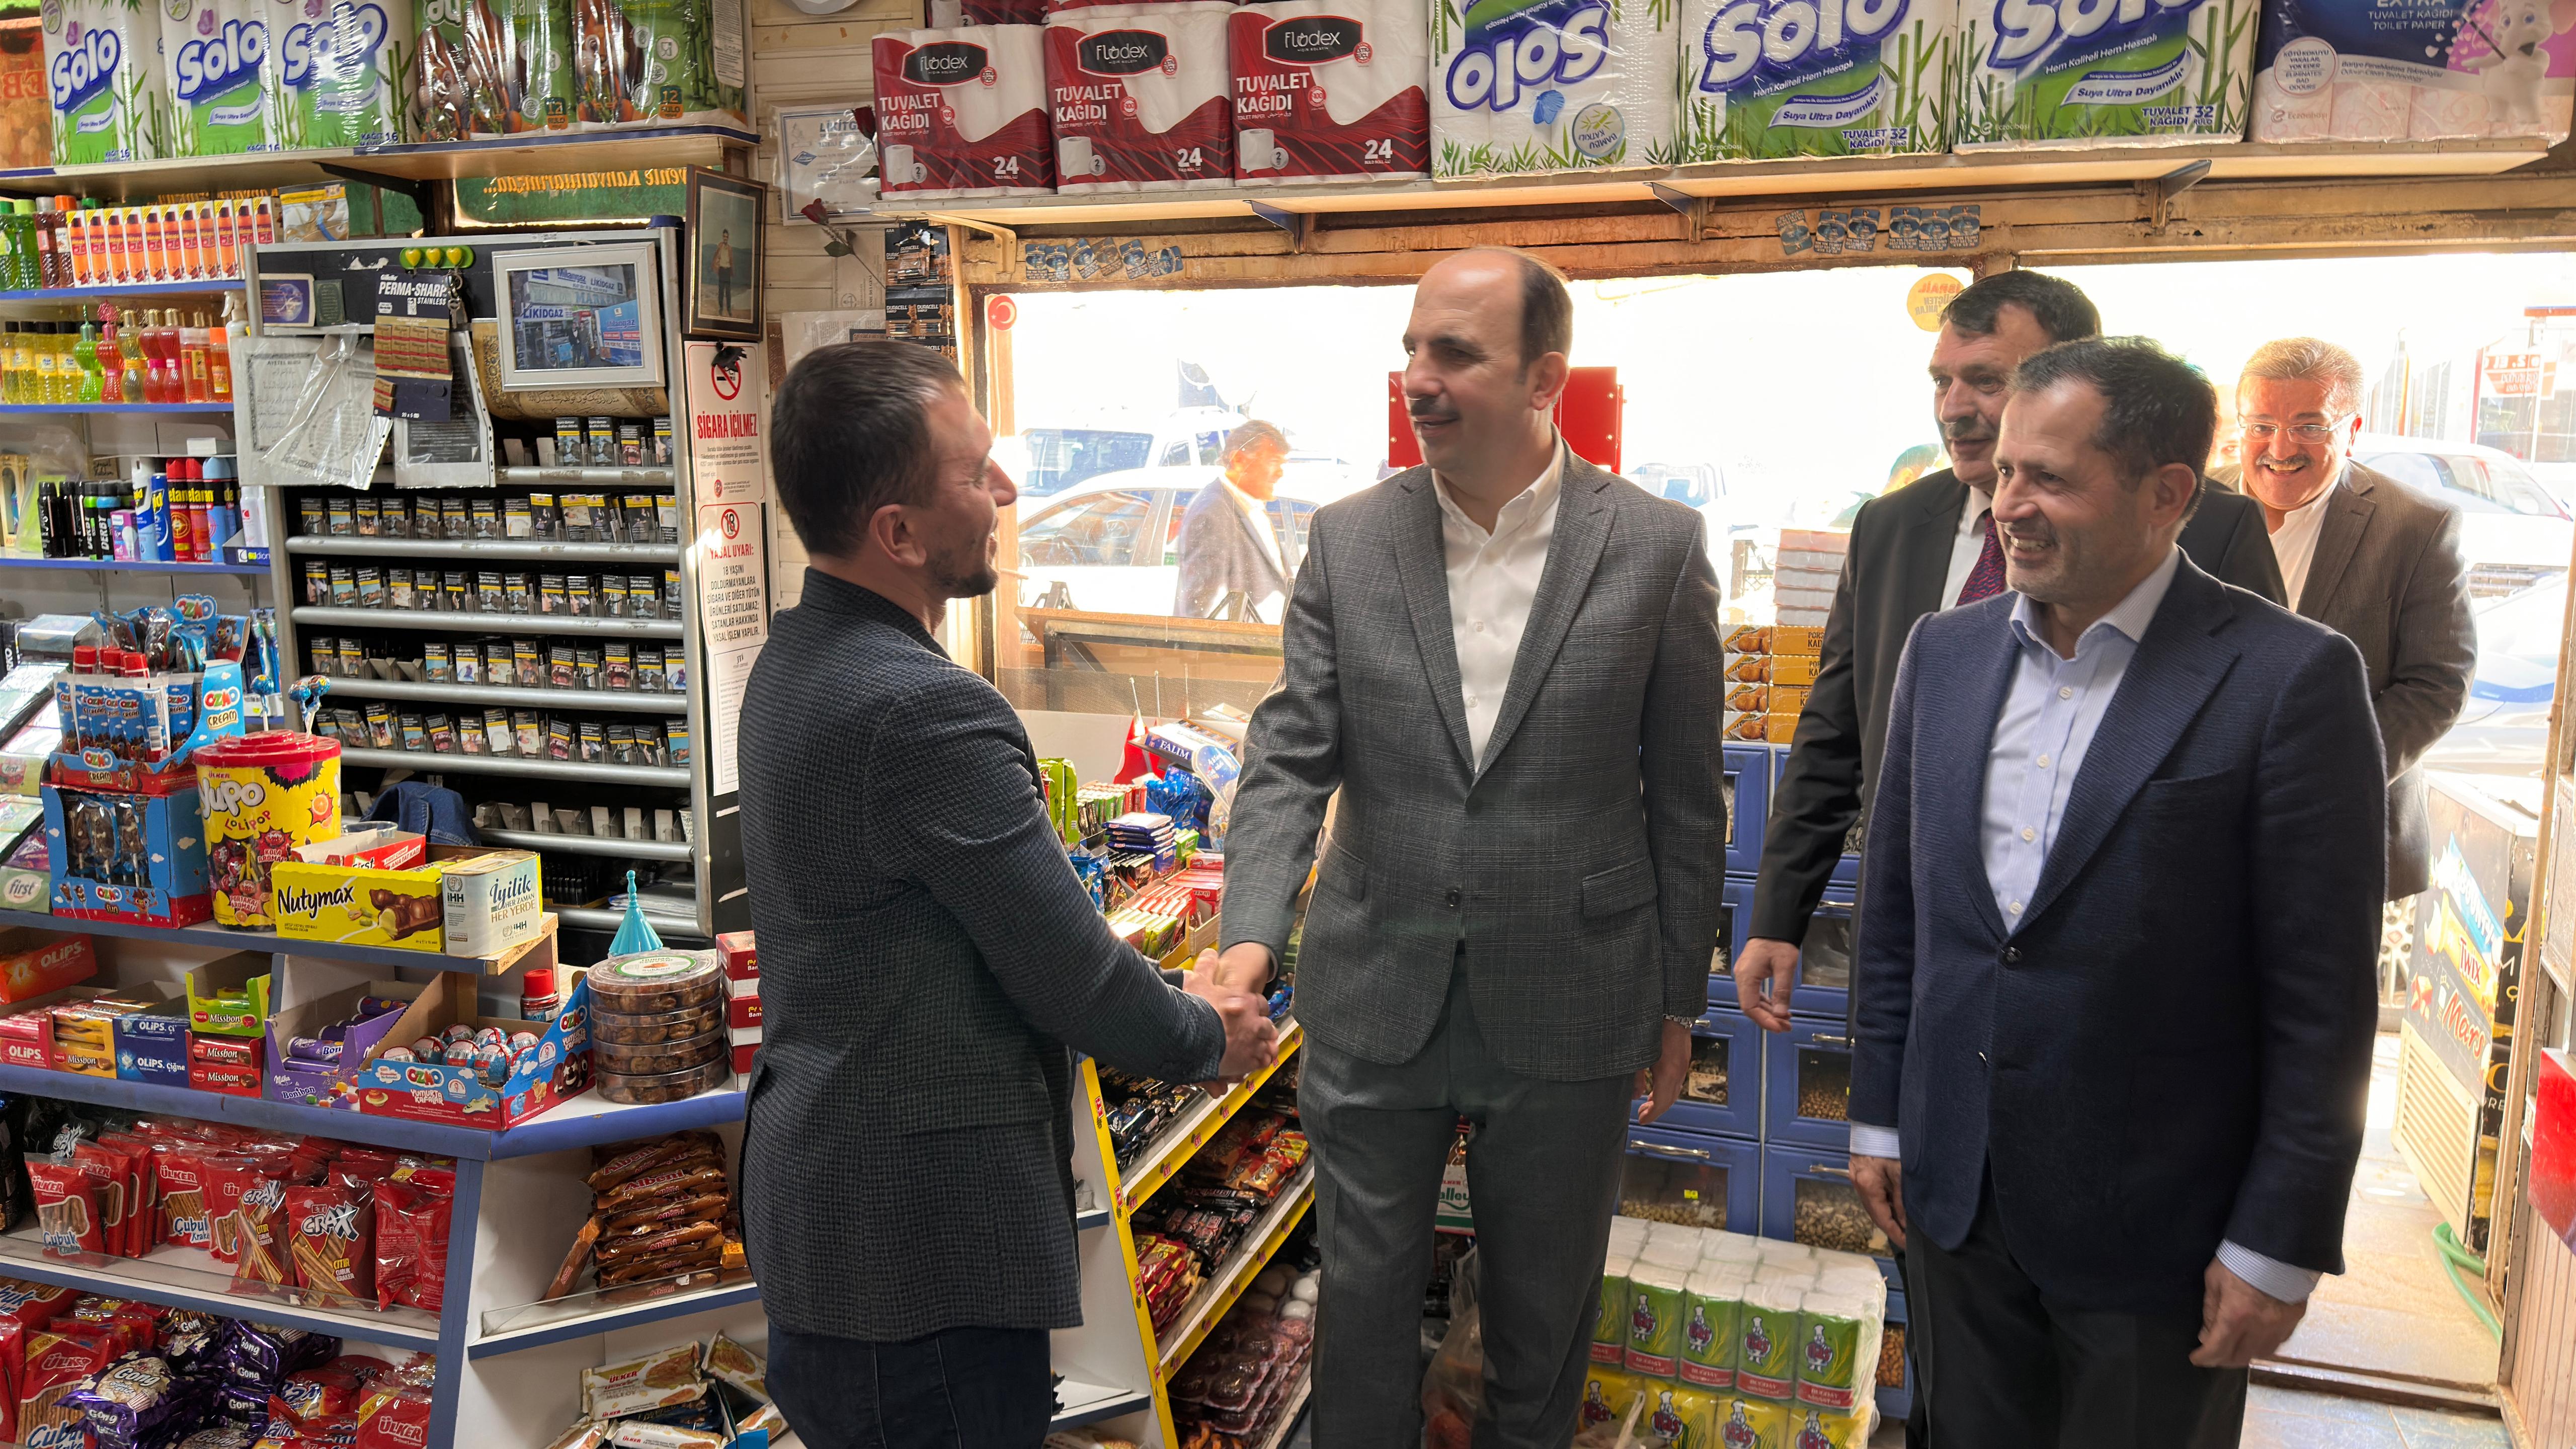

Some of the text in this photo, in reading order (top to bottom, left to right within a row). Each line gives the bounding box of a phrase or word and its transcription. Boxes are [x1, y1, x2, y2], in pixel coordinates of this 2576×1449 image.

[2368, 11, 2412, 19] TUVALET
[2373, 20, 2445, 31] TOILET PAPER
[2045, 33, 2157, 75] Hem Kaliteli Hem Hesaplı
[1237, 72, 1310, 93] TUVALET
[1774, 76, 1801, 92] Kaliteli
[1802, 71, 1822, 83] Hem
[1823, 60, 1854, 77] Hesaplı
[1055, 84, 1121, 102] TUVALET
[2078, 88, 2103, 98] Suya
[2107, 88, 2132, 97] Ultra
[879, 93, 940, 112] TUVALET
[1237, 92, 1292, 113] KAĞIDI
[1057, 101, 1106, 122] KAĞIDI
[1783, 111, 1806, 121] Suya
[1809, 112, 1832, 121] Ultra
[2142, 106, 2214, 118] TUVALET 32
[882, 110, 929, 130] KAĞIDI
[2149, 116, 2189, 127] KAĞIDI
[1589, 133, 1618, 149] BAMBU
[1842, 128, 1908, 140] TUVALET 32
[1365, 139, 1393, 160] 24
[1849, 137, 1885, 149] KAĞIDI
[1177, 147, 1202, 167] 24
[993, 156, 1019, 175] 24
[417, 297, 446, 305] STAINLESS
[697, 410, 758, 441] SİGARA İÇİLMEZ
[723, 564, 744, 576] 18 YAŞINI
[711, 576, 755, 590] DOLDURMAYANLARA
[707, 587, 760, 604] SİGARA VE DİĞER TÜTÜN
[709, 604, 732, 617] ÜRÜNLERİ
[711, 613, 758, 629] SATANLAR HAKKINDA
[713, 632, 727, 643] YASAL
[727, 628, 741, 642] İŞLEM
[208, 710, 237, 729] CREAM
[1160, 740, 1189, 760] FALIM
[89, 771, 112, 783] CREAM
[209, 770, 230, 778] ÜLKER
[9, 879, 34, 896] first
[490, 874, 531, 910] İyilik
[278, 885, 355, 919] Nutymax
[505, 893, 535, 908] HER ZAMAN
[491, 901, 536, 923] HER YERDE
[210, 1013, 240, 1023] Missbon
[2442, 989, 2485, 1060] Mars
[67, 1055, 96, 1065] Missbon
[207, 1048, 237, 1058] Missbon
[208, 1072, 238, 1082] Missbon
[282, 1085, 315, 1100] Bonibon
[410, 1088, 442, 1099] YUMURTA
[603, 1147, 657, 1175] Albeni
[160, 1165, 197, 1182] ÜLKER
[622, 1169, 685, 1192] Albeni
[32, 1175, 64, 1194] ÜLKER
[243, 1180, 281, 1209] CRAX
[301, 1200, 360, 1242] CRAX
[657, 1210, 685, 1221] Albeni
[649, 1240, 677, 1251] Albeni
[241, 1336, 260, 1356] Gong
[114, 1367, 161, 1386] Gong
[237, 1367, 260, 1380] Gong
[609, 1371, 637, 1383] ÜLKER
[229, 1399, 255, 1410] Gong
[89, 1409, 118, 1424] Gong
[378, 1415, 422, 1442] ÜLKER
